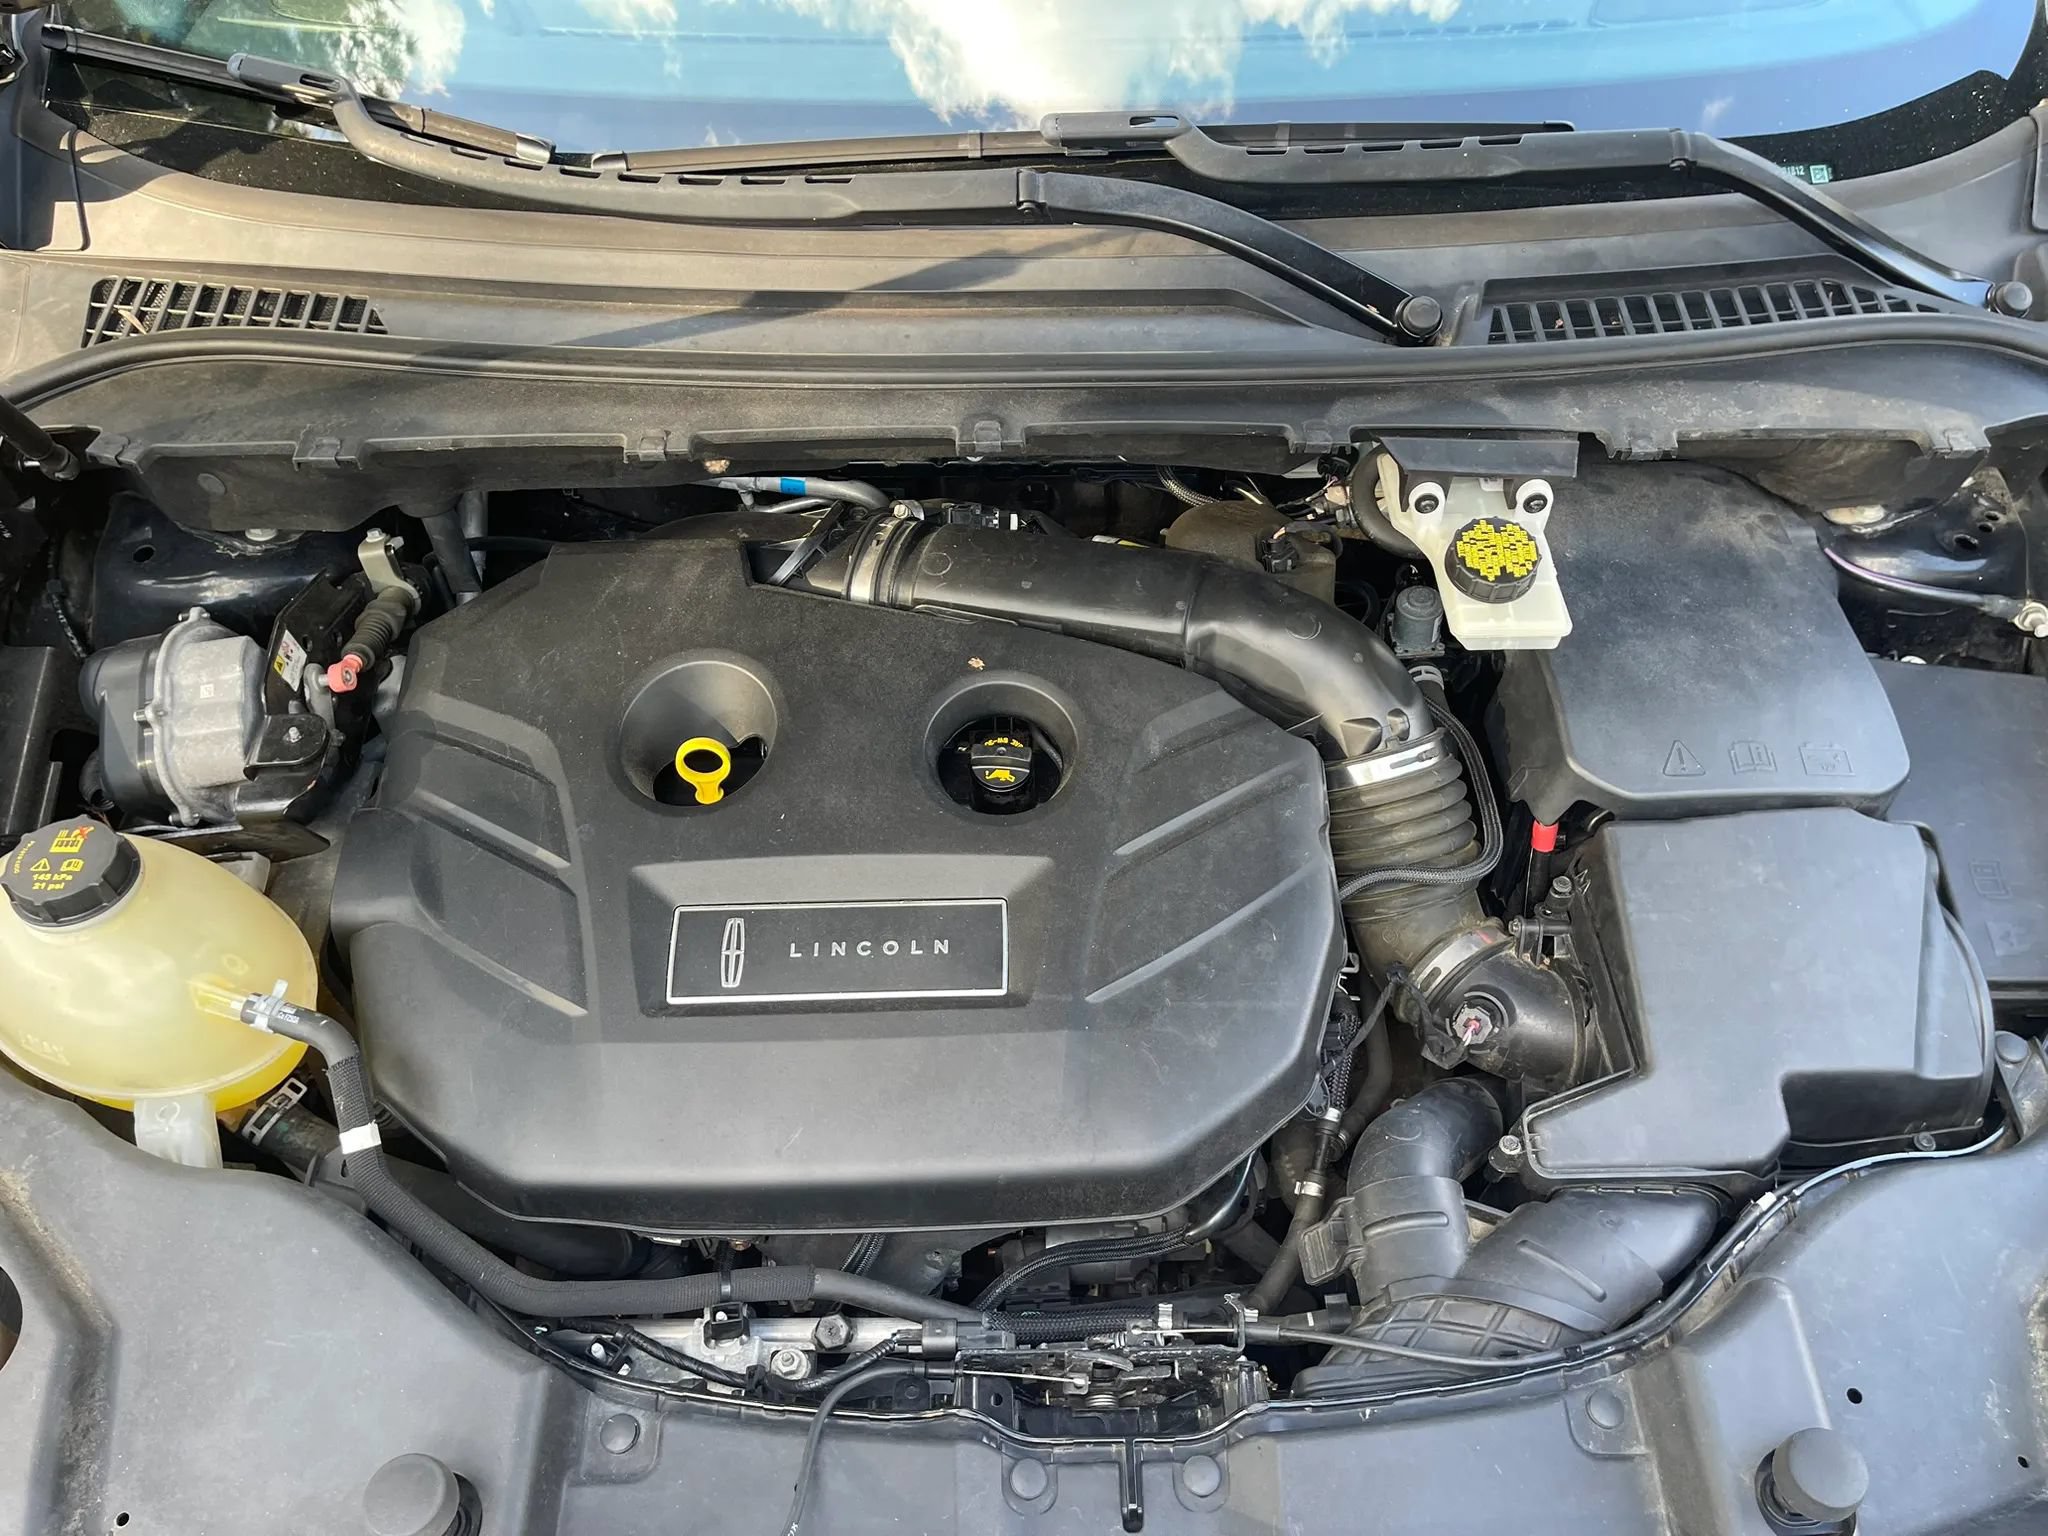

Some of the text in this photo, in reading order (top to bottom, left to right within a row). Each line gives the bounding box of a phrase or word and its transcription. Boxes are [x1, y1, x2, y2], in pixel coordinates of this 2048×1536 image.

[32, 881, 65, 891] 21 psi
[789, 939, 951, 959] LINCOLN
